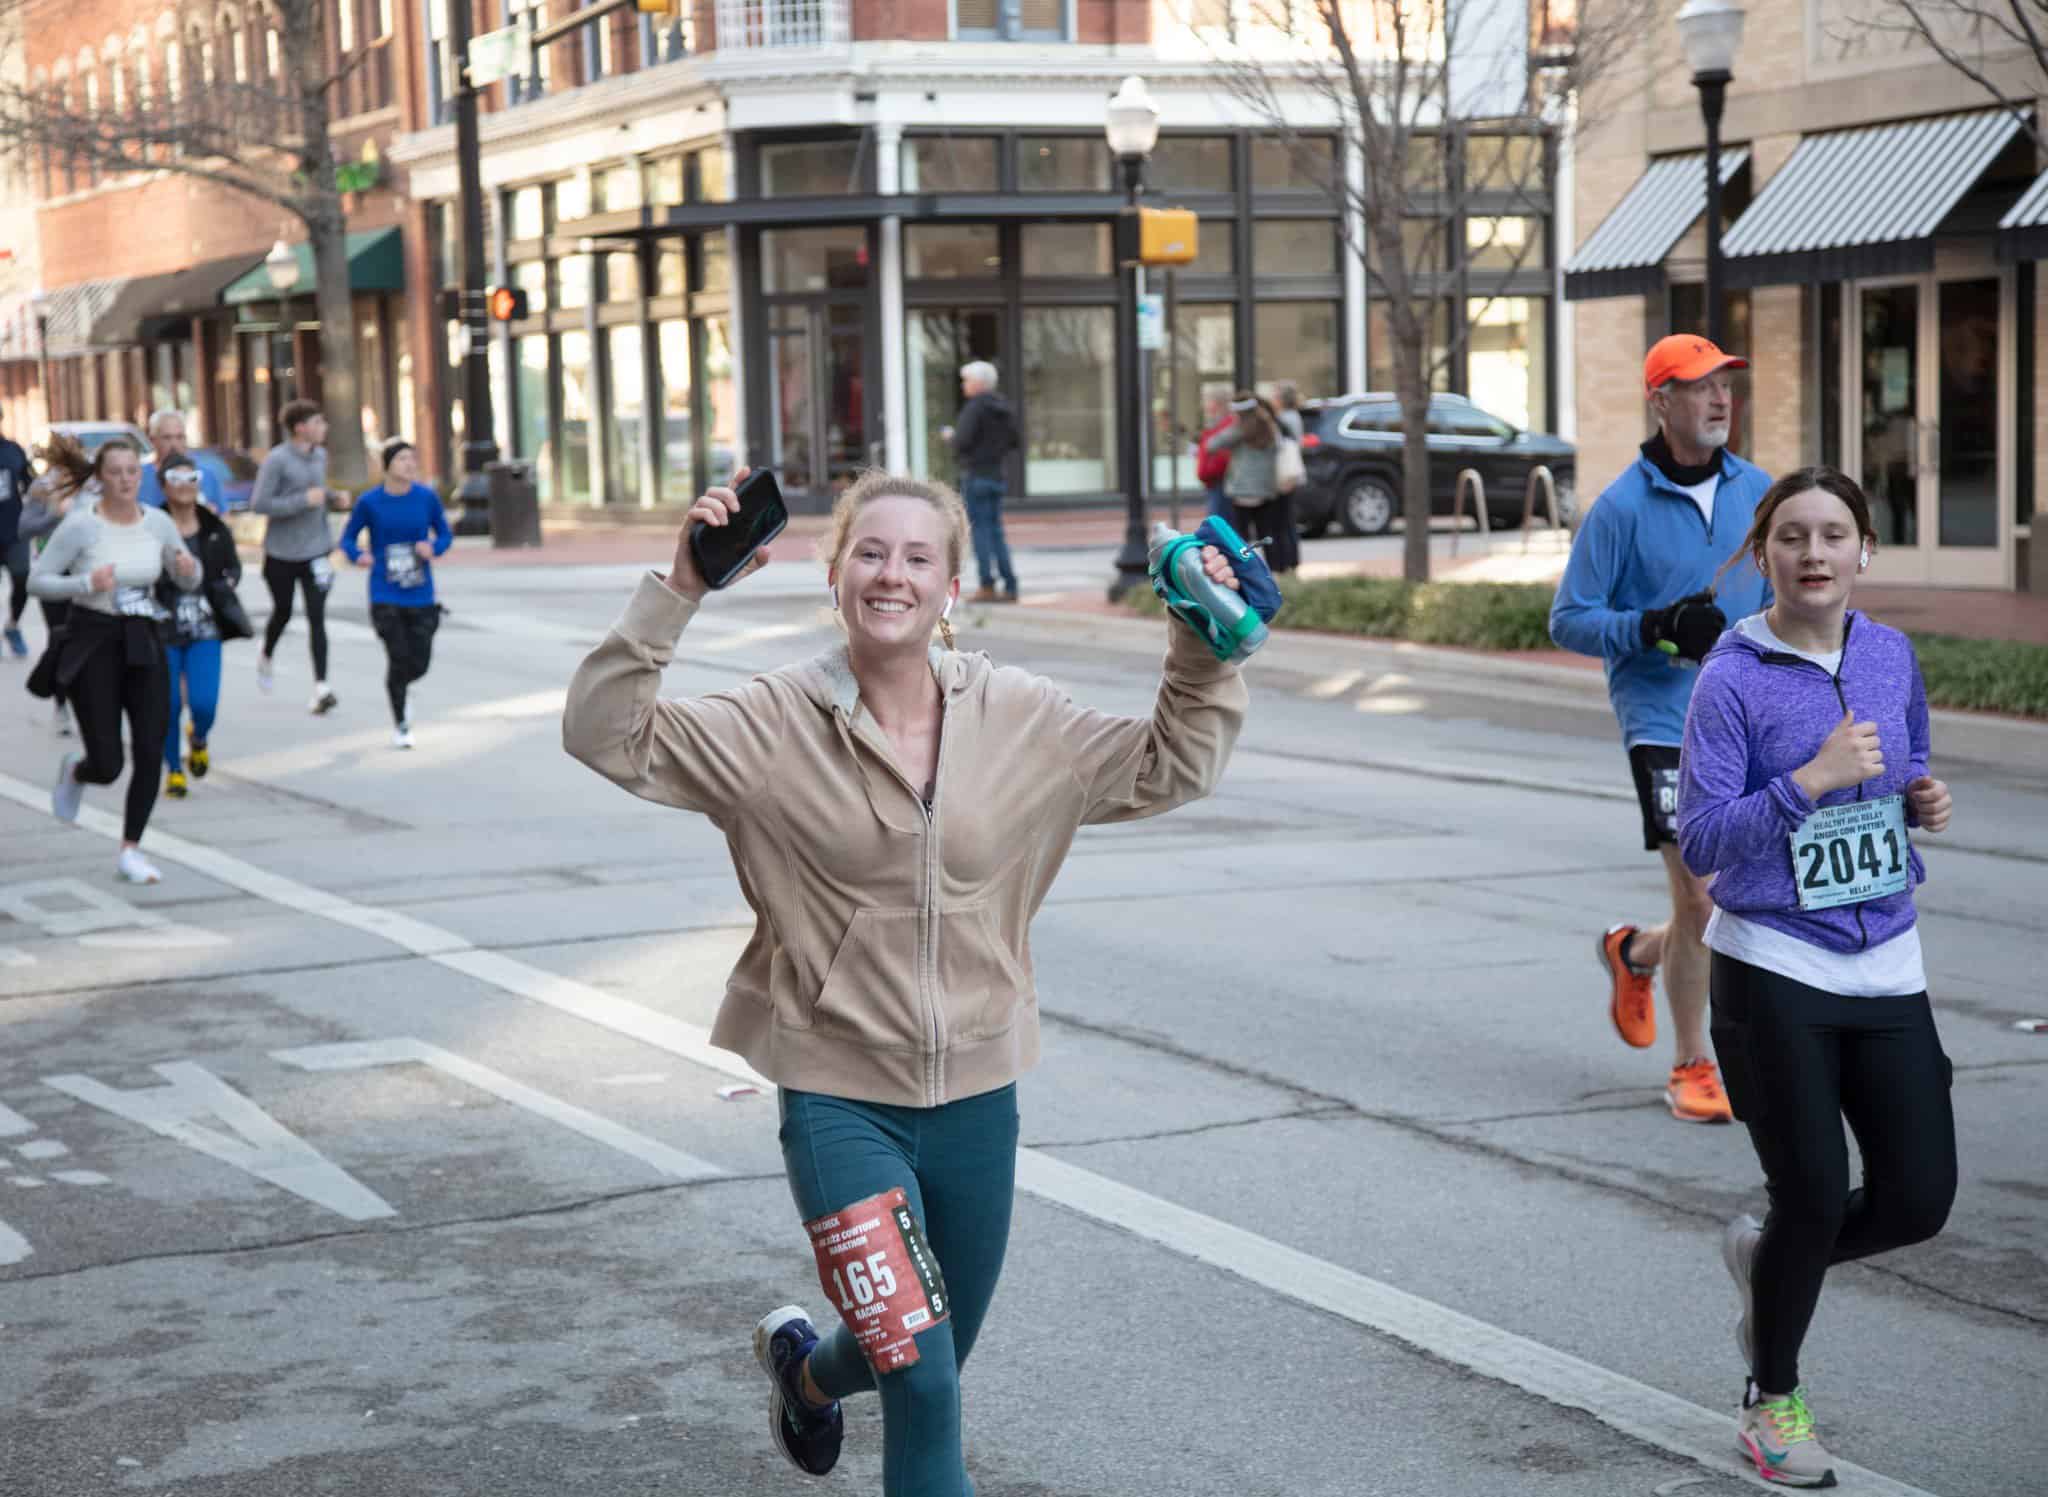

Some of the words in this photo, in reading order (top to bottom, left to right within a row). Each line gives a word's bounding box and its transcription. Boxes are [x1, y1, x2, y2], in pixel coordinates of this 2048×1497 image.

[1814, 818, 1846, 830] HEALTHY
[1861, 811, 1883, 822] RELAY
[1821, 810, 1834, 819] THE
[1837, 803, 1872, 815] COWTOWN
[1814, 830, 1838, 841] ANGUS
[1840, 826, 1857, 836] COW
[1857, 821, 1886, 833] PATTIES
[1799, 829, 1902, 889] 2041
[1849, 884, 1872, 896] RELAY
[899, 1212, 912, 1230] 5
[931, 1293, 943, 1312] 5
[832, 1250, 897, 1311] 165
[854, 1301, 889, 1321] RACHEL
